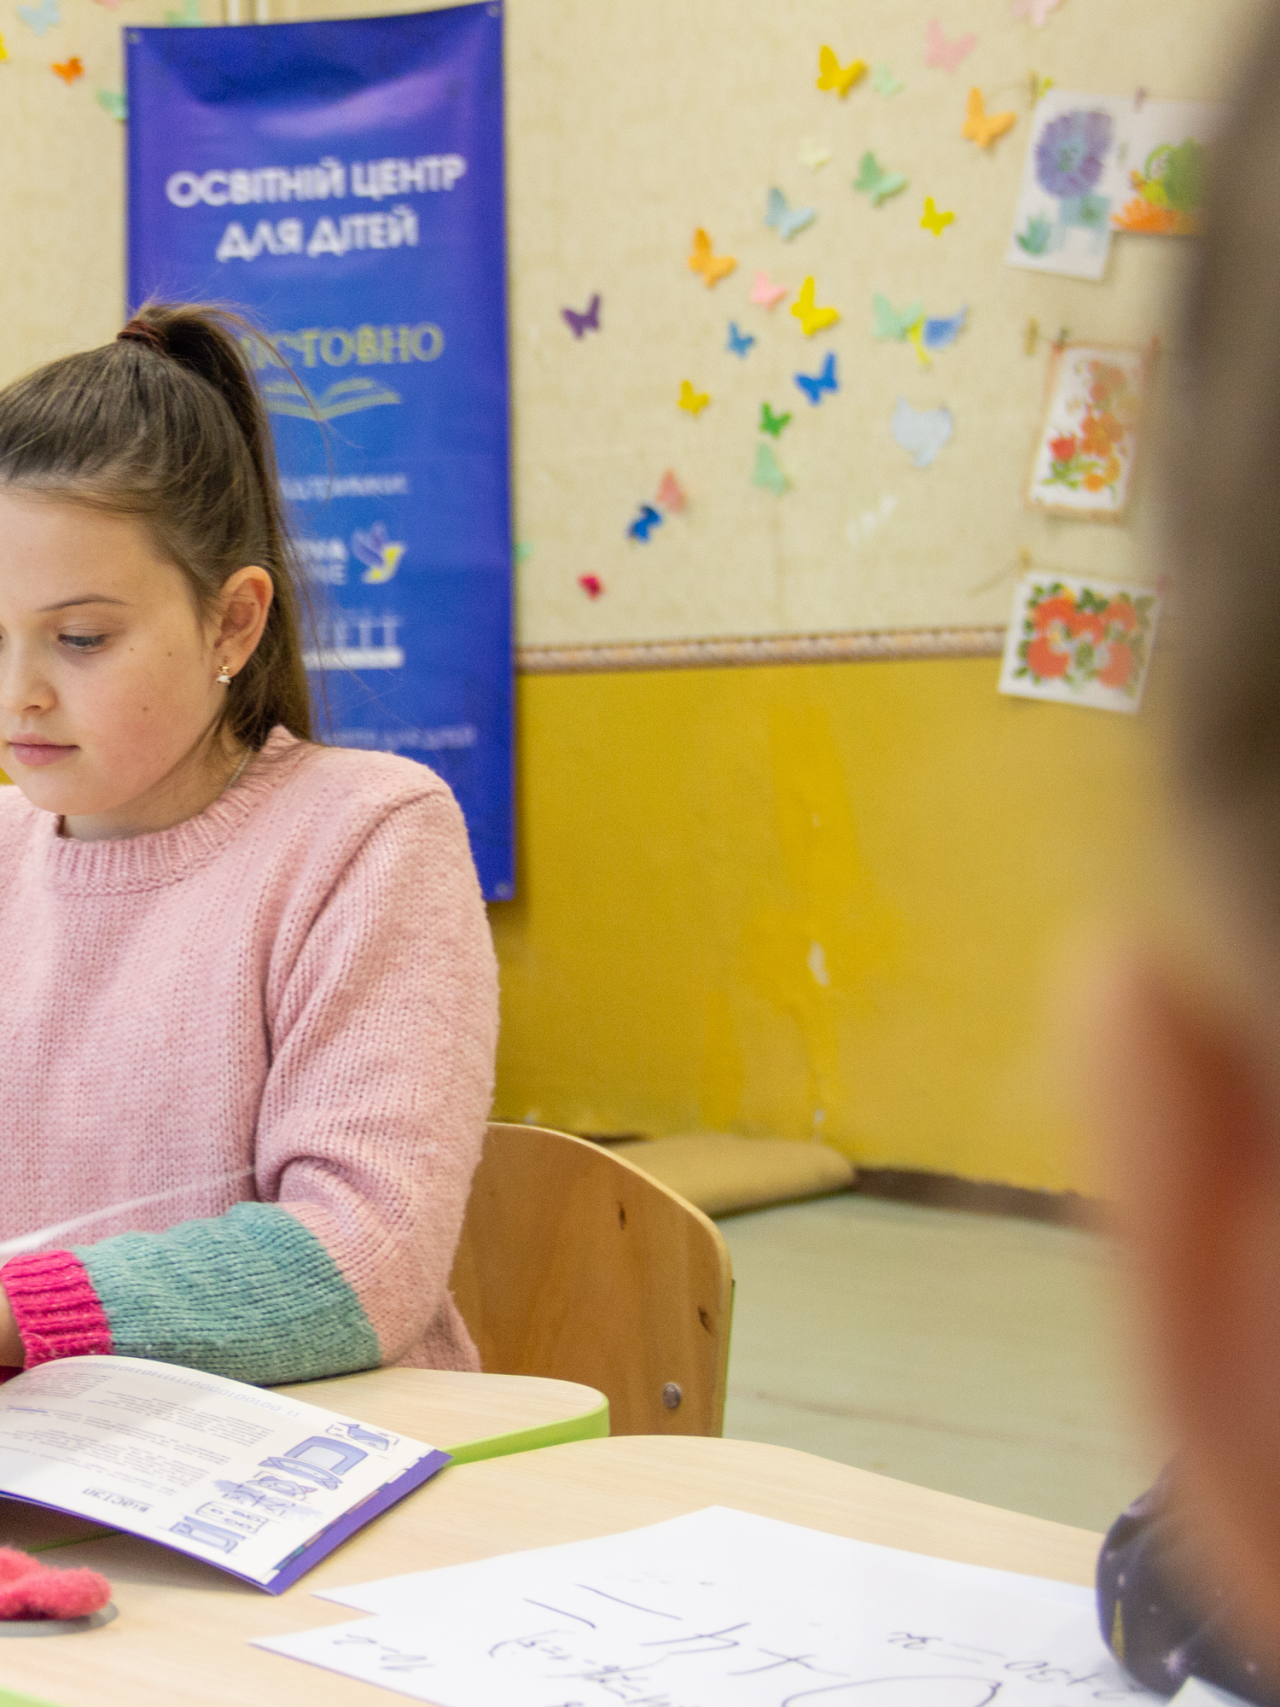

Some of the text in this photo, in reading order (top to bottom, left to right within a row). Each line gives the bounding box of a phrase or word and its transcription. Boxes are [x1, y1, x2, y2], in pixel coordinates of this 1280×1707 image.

[166, 153, 467, 208] ОСВІТНІЙ ЦЕНТР
[215, 204, 418, 263] ДЛЯ ДІТЕЙ
